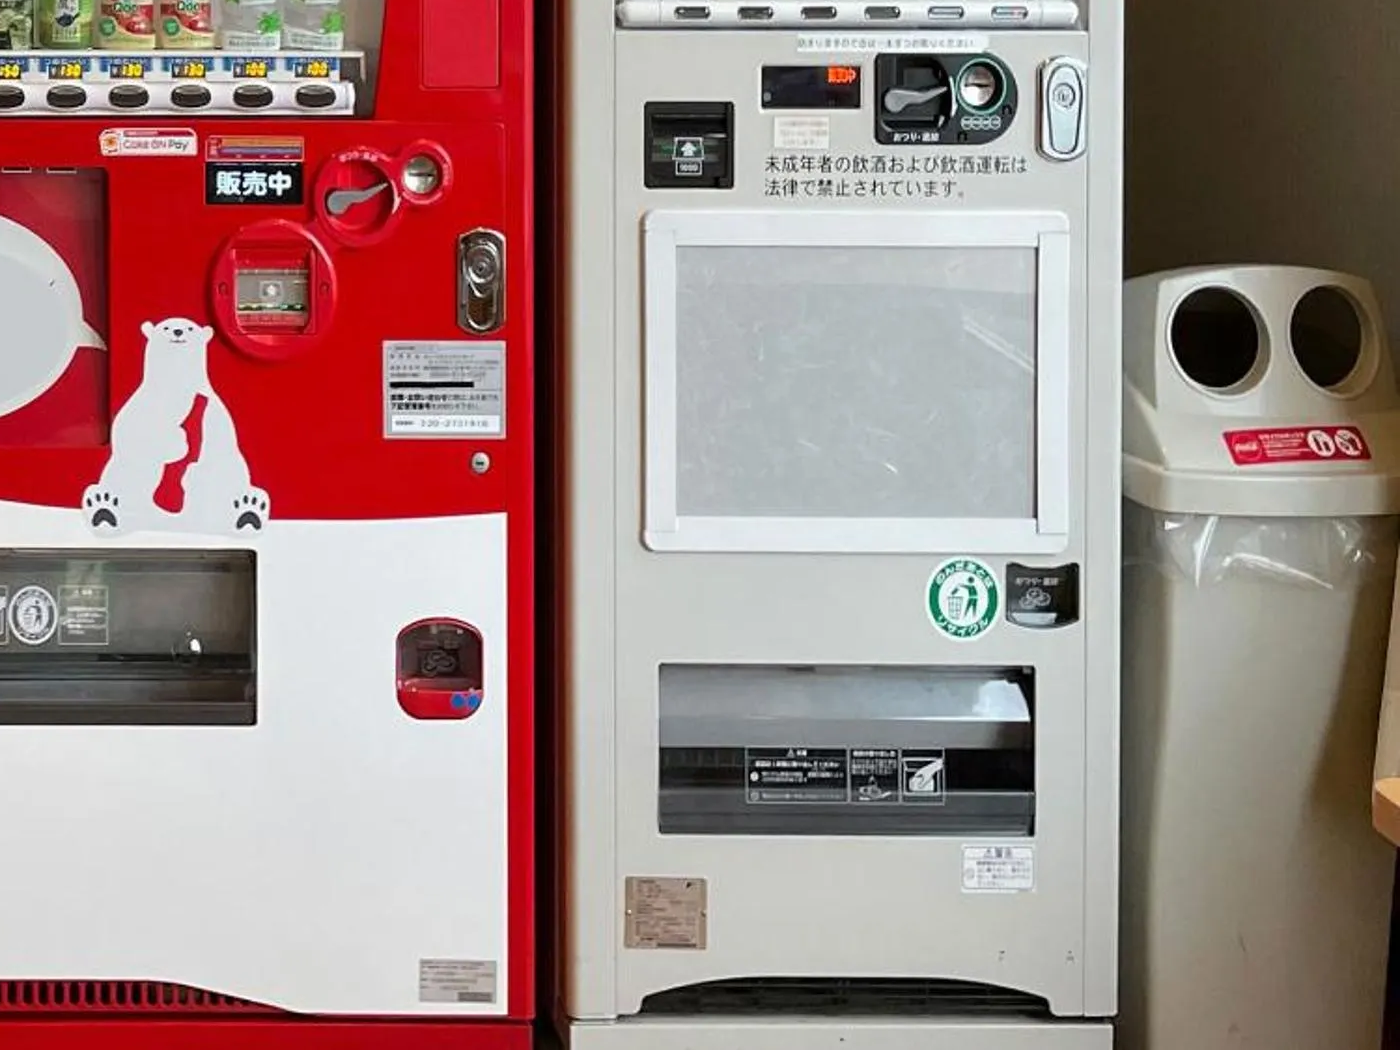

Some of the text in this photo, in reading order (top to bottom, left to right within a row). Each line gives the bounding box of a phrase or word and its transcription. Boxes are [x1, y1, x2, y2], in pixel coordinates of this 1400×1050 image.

[168, 139, 189, 151] Pay
[765, 155, 1028, 174] 未成年者の飲酒および飲酒運転は
[216, 171, 292, 196] 販売中
[764, 178, 964, 198] 法律で禁止されています。
[937, 615, 989, 636] リサイクル
